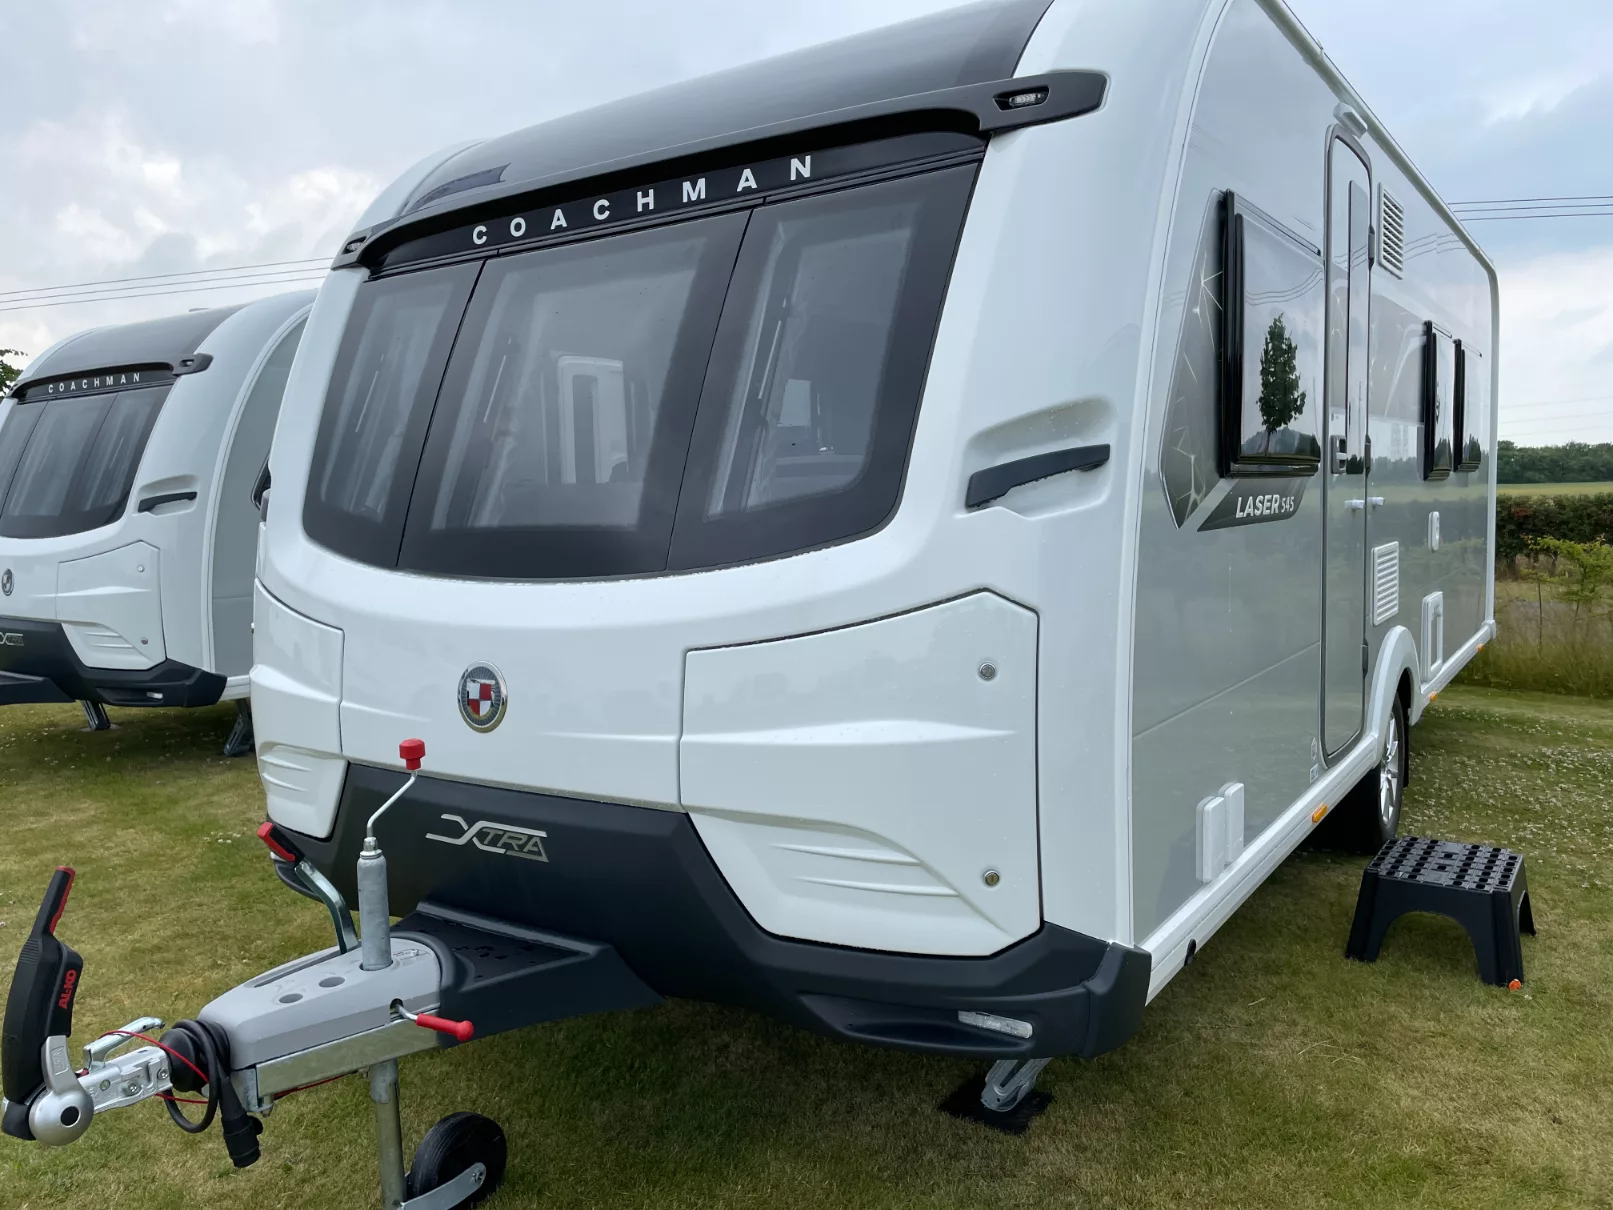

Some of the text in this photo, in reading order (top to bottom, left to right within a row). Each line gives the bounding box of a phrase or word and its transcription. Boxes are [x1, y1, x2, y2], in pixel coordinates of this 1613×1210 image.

[472, 155, 812, 245] COACHMAN
[48, 372, 140, 393] COACHMAN
[1235, 494, 1295, 519] LASER 545
[425, 813, 549, 863] XTRA
[58, 969, 77, 1009] AL-KO
